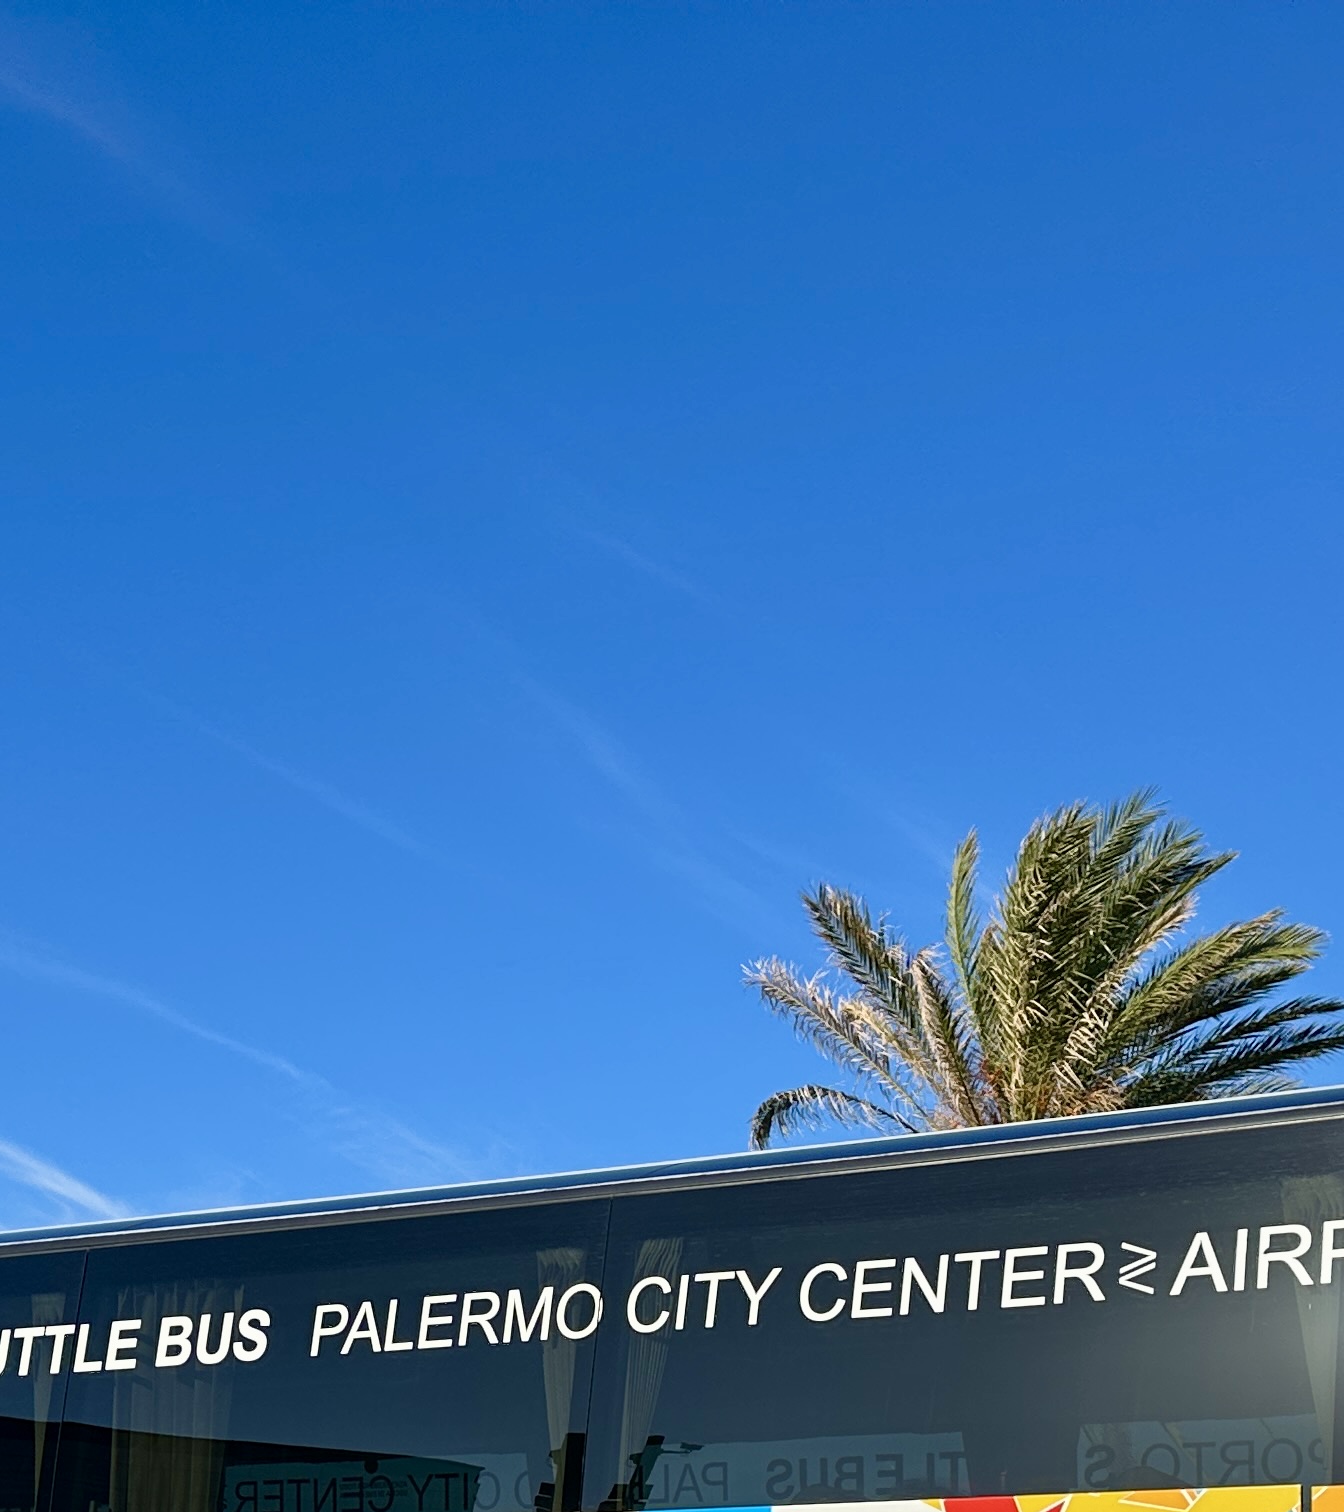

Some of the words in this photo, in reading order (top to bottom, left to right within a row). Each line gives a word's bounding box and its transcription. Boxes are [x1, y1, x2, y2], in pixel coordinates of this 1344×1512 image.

[156, 1309, 271, 1368] BUS
[309, 1282, 604, 1357] PALERMO
[626, 1267, 782, 1334] CITY
[799, 1241, 1106, 1321] CENTER
